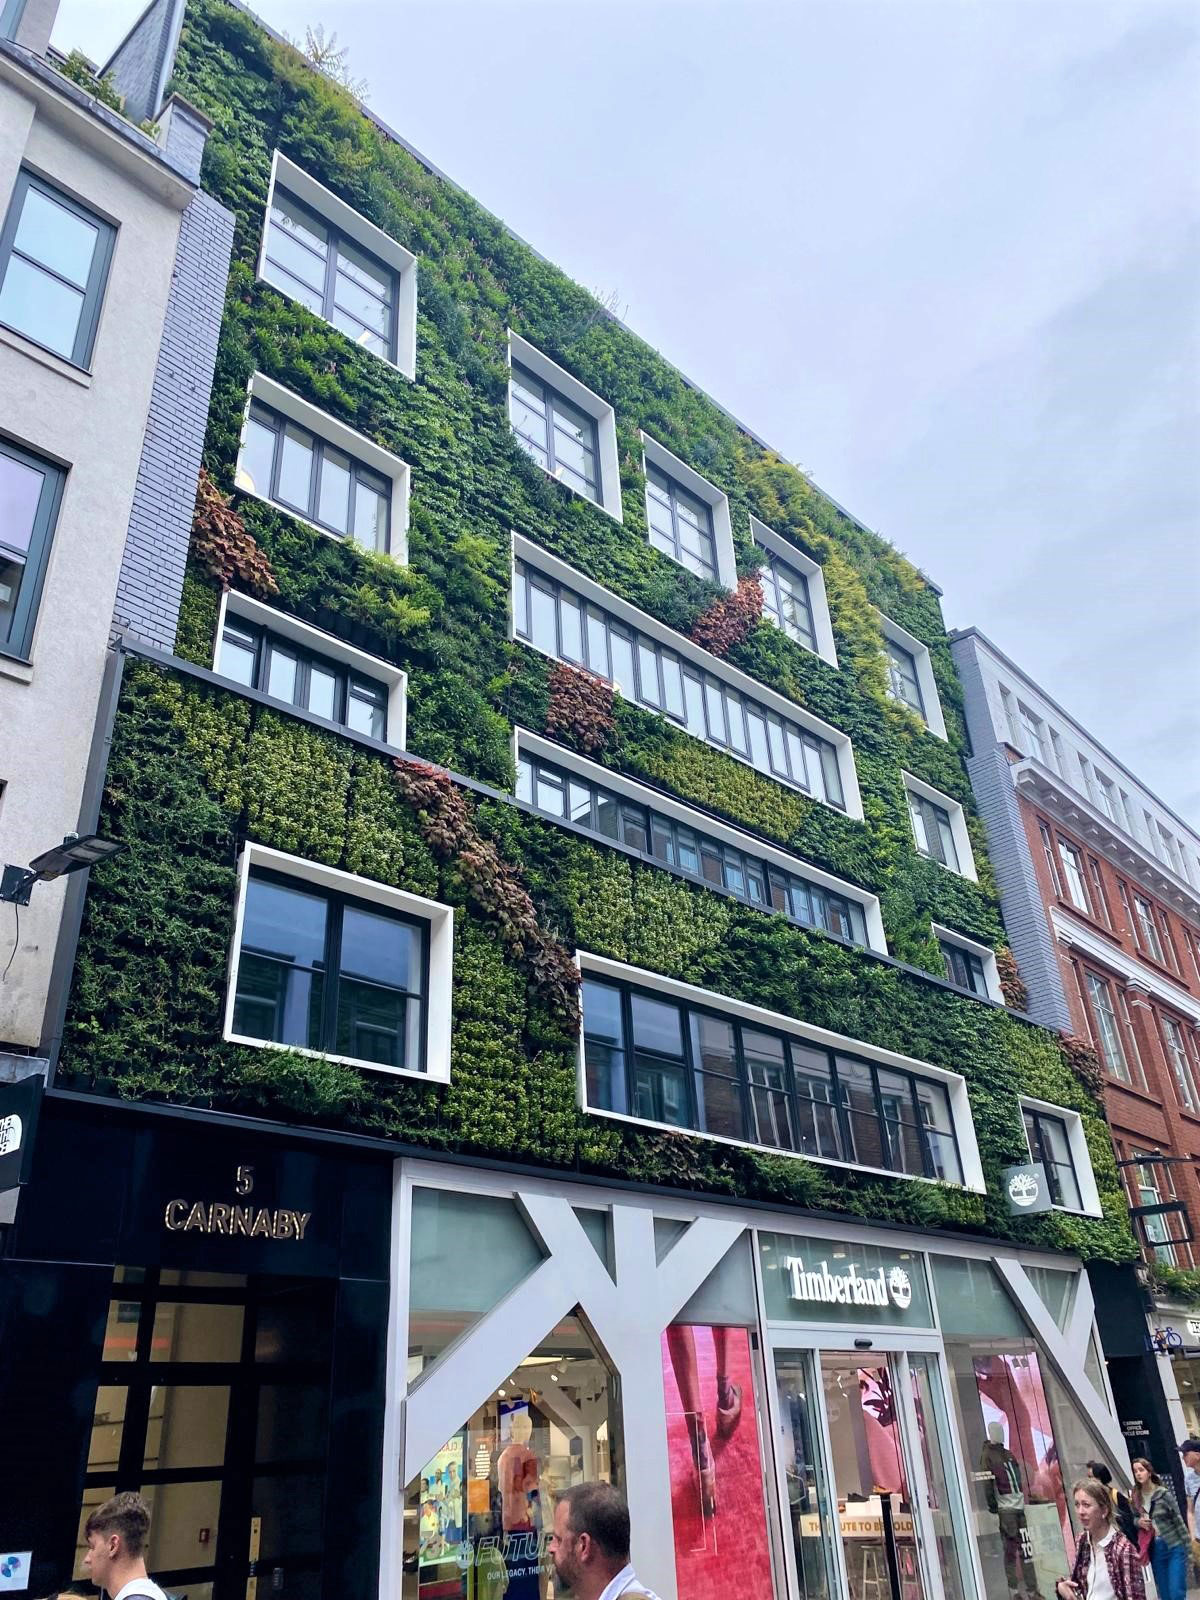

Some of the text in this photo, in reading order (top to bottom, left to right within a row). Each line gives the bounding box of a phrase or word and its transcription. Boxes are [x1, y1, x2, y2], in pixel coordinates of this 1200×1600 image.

[235, 1165, 255, 1195] 5
[164, 1199, 312, 1240] CARNABY
[784, 1255, 889, 1306] Timberland
[859, 1521, 872, 1532] TO
[892, 1521, 913, 1531] OLD
